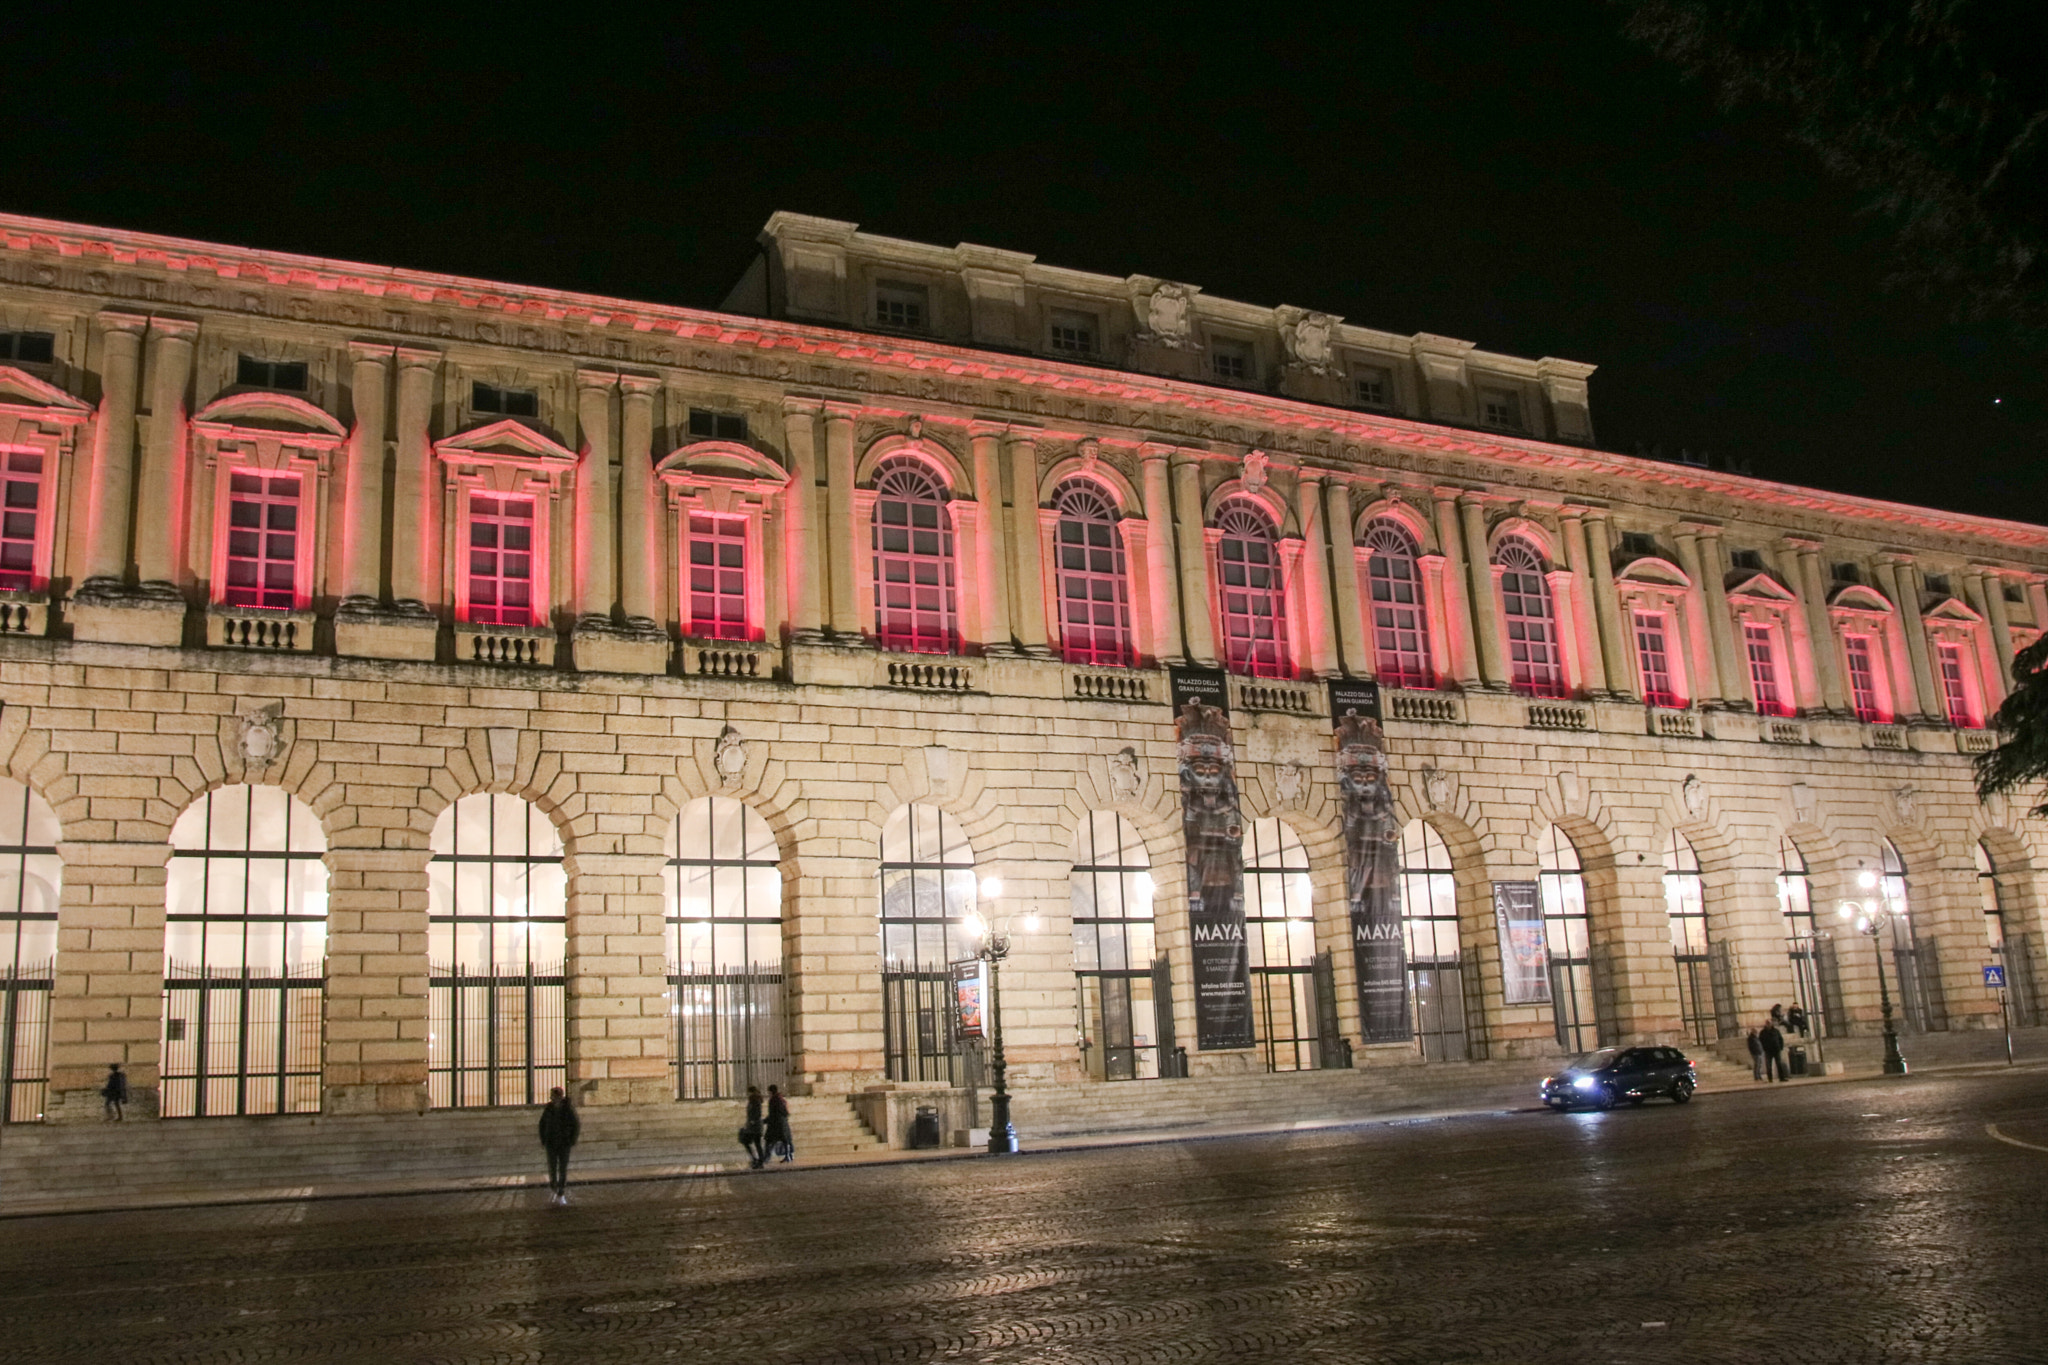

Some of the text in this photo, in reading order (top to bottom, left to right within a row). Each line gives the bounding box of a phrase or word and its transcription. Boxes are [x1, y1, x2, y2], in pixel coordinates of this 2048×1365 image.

[1335, 690, 1358, 698] PALAZZO
[1194, 923, 1244, 941] MAYA
[1356, 923, 1402, 941] MAYA
